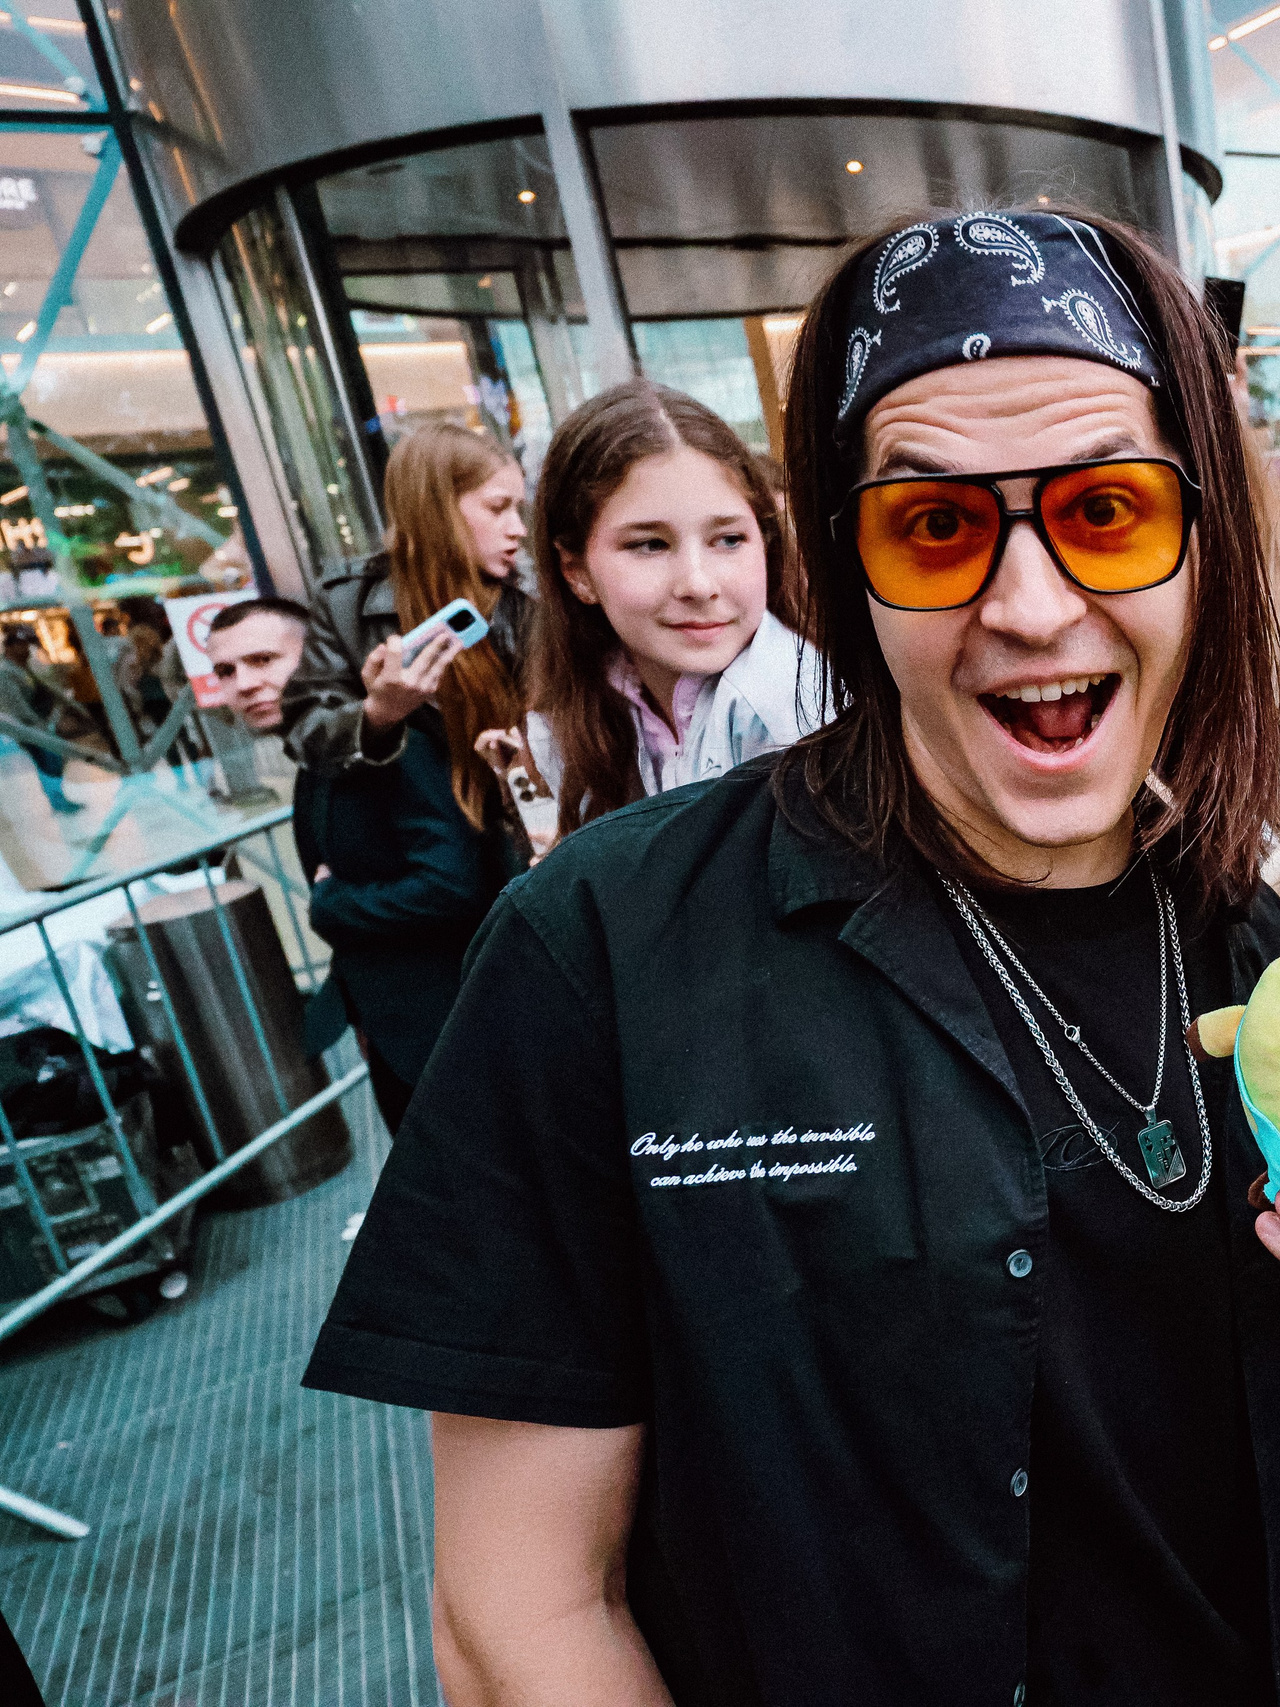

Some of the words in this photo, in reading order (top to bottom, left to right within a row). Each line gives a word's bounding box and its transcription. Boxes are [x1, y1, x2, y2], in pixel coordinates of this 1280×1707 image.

[630, 1132, 680, 1161] Only
[680, 1133, 704, 1153] he
[706, 1129, 743, 1150] who
[770, 1126, 798, 1145] the
[800, 1122, 876, 1143] invisible
[650, 1175, 681, 1187] can
[682, 1163, 747, 1185] achieve
[768, 1153, 858, 1182] impossible.
